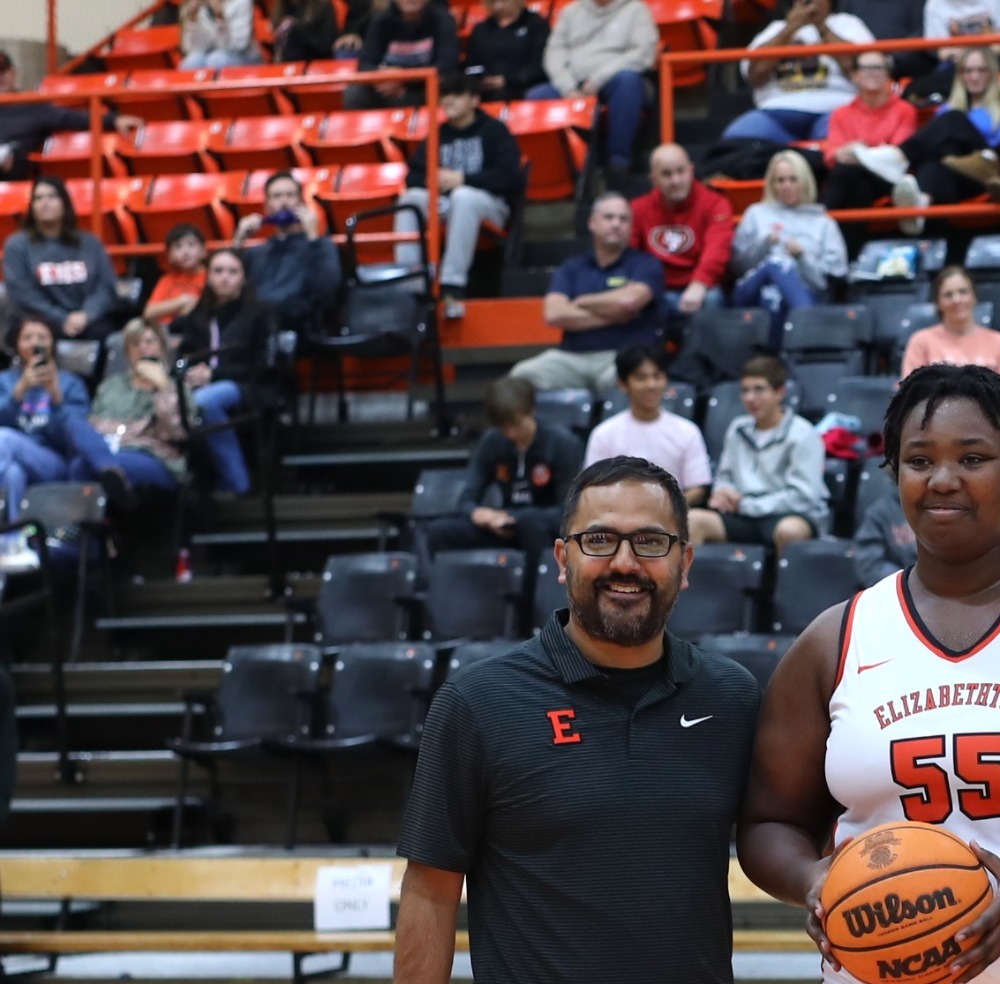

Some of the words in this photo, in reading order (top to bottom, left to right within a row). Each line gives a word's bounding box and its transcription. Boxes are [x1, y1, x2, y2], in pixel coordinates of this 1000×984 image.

[546, 708, 582, 746] E
[842, 885, 957, 938] Wilson
[877, 937, 962, 979] NCAA
